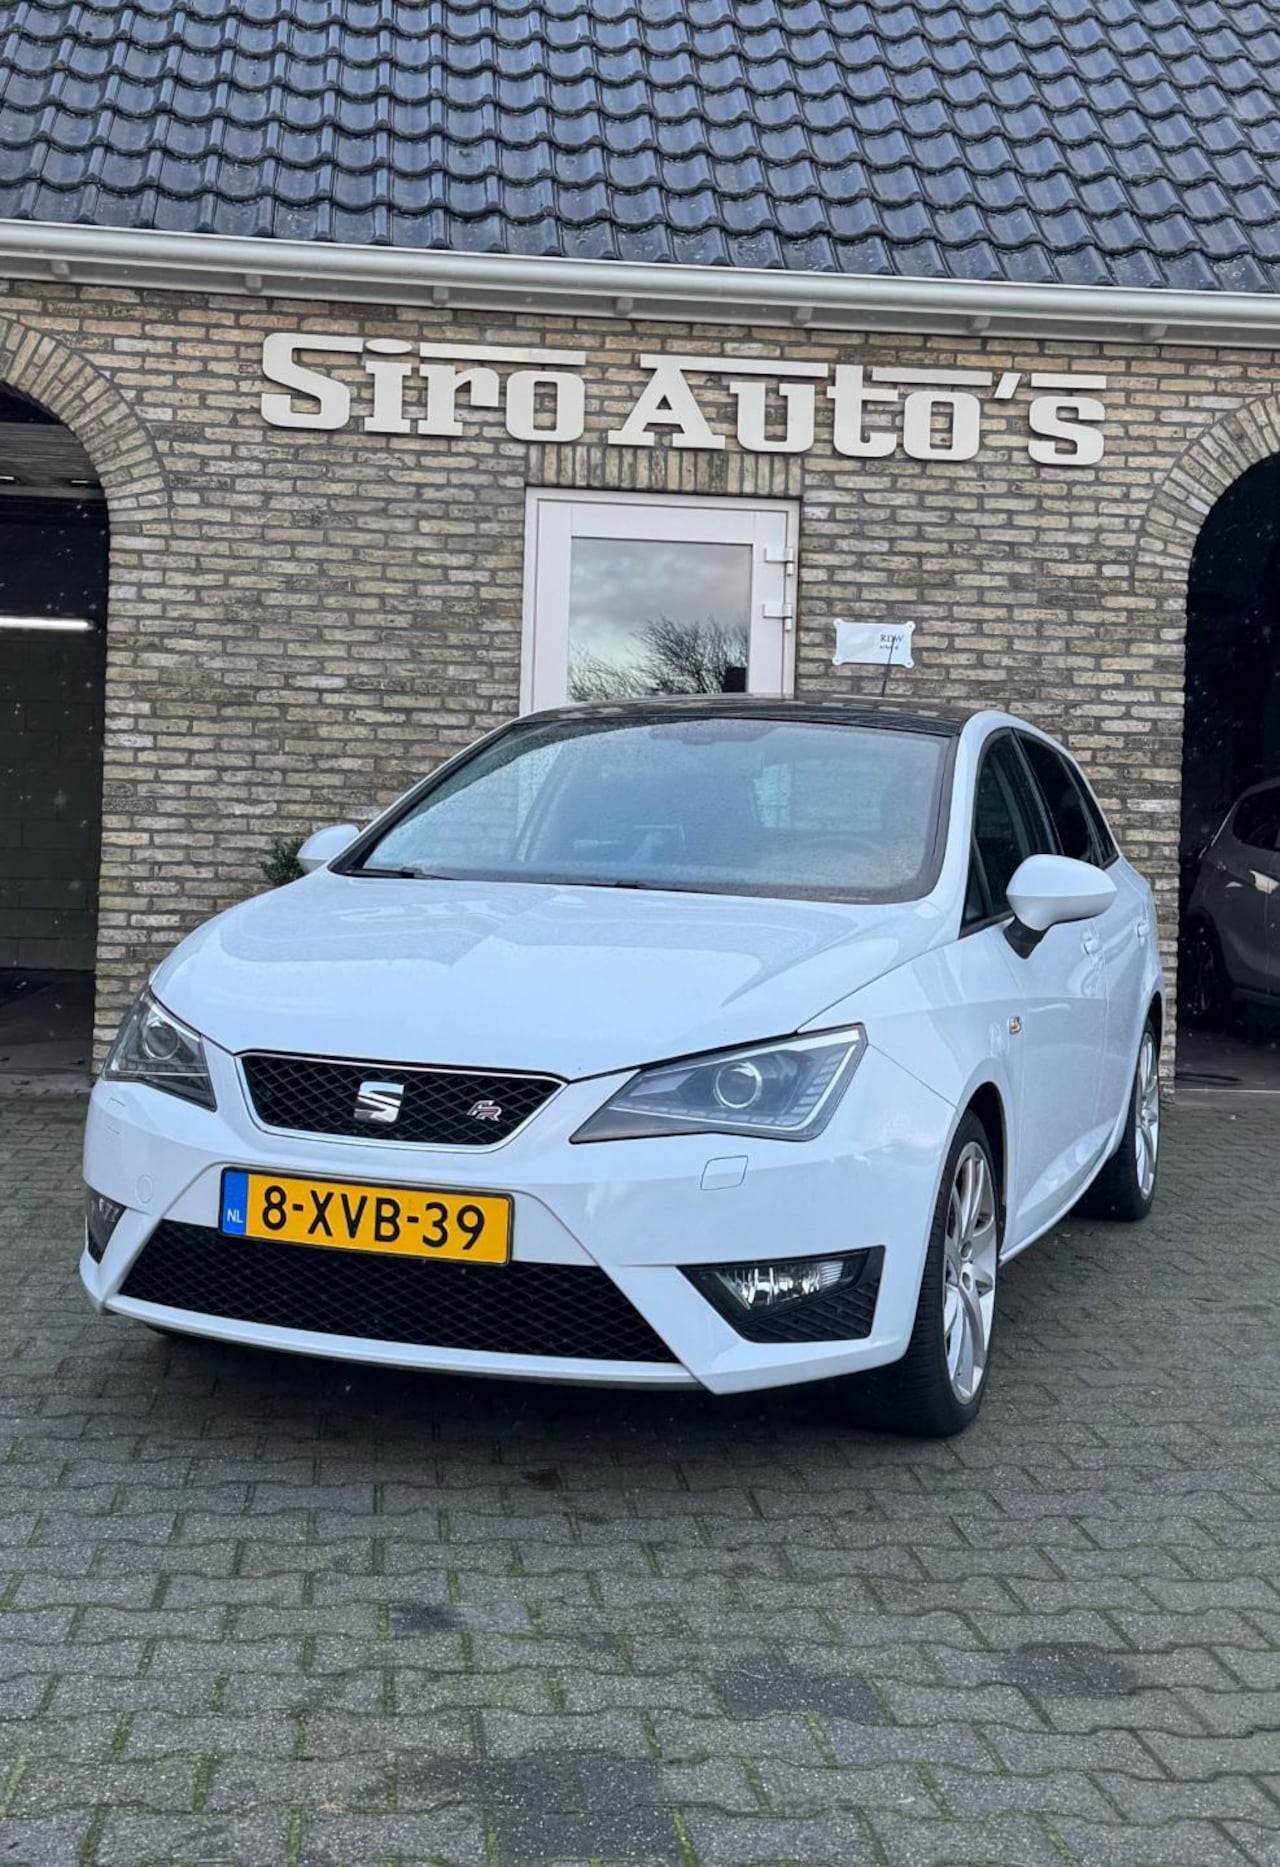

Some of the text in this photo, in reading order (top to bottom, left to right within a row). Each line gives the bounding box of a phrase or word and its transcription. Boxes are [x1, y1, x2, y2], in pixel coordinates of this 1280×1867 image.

[260, 332, 1108, 466] Siro Auto's
[227, 1208, 244, 1224] NL
[262, 1185, 485, 1250] 8-XVB-39
